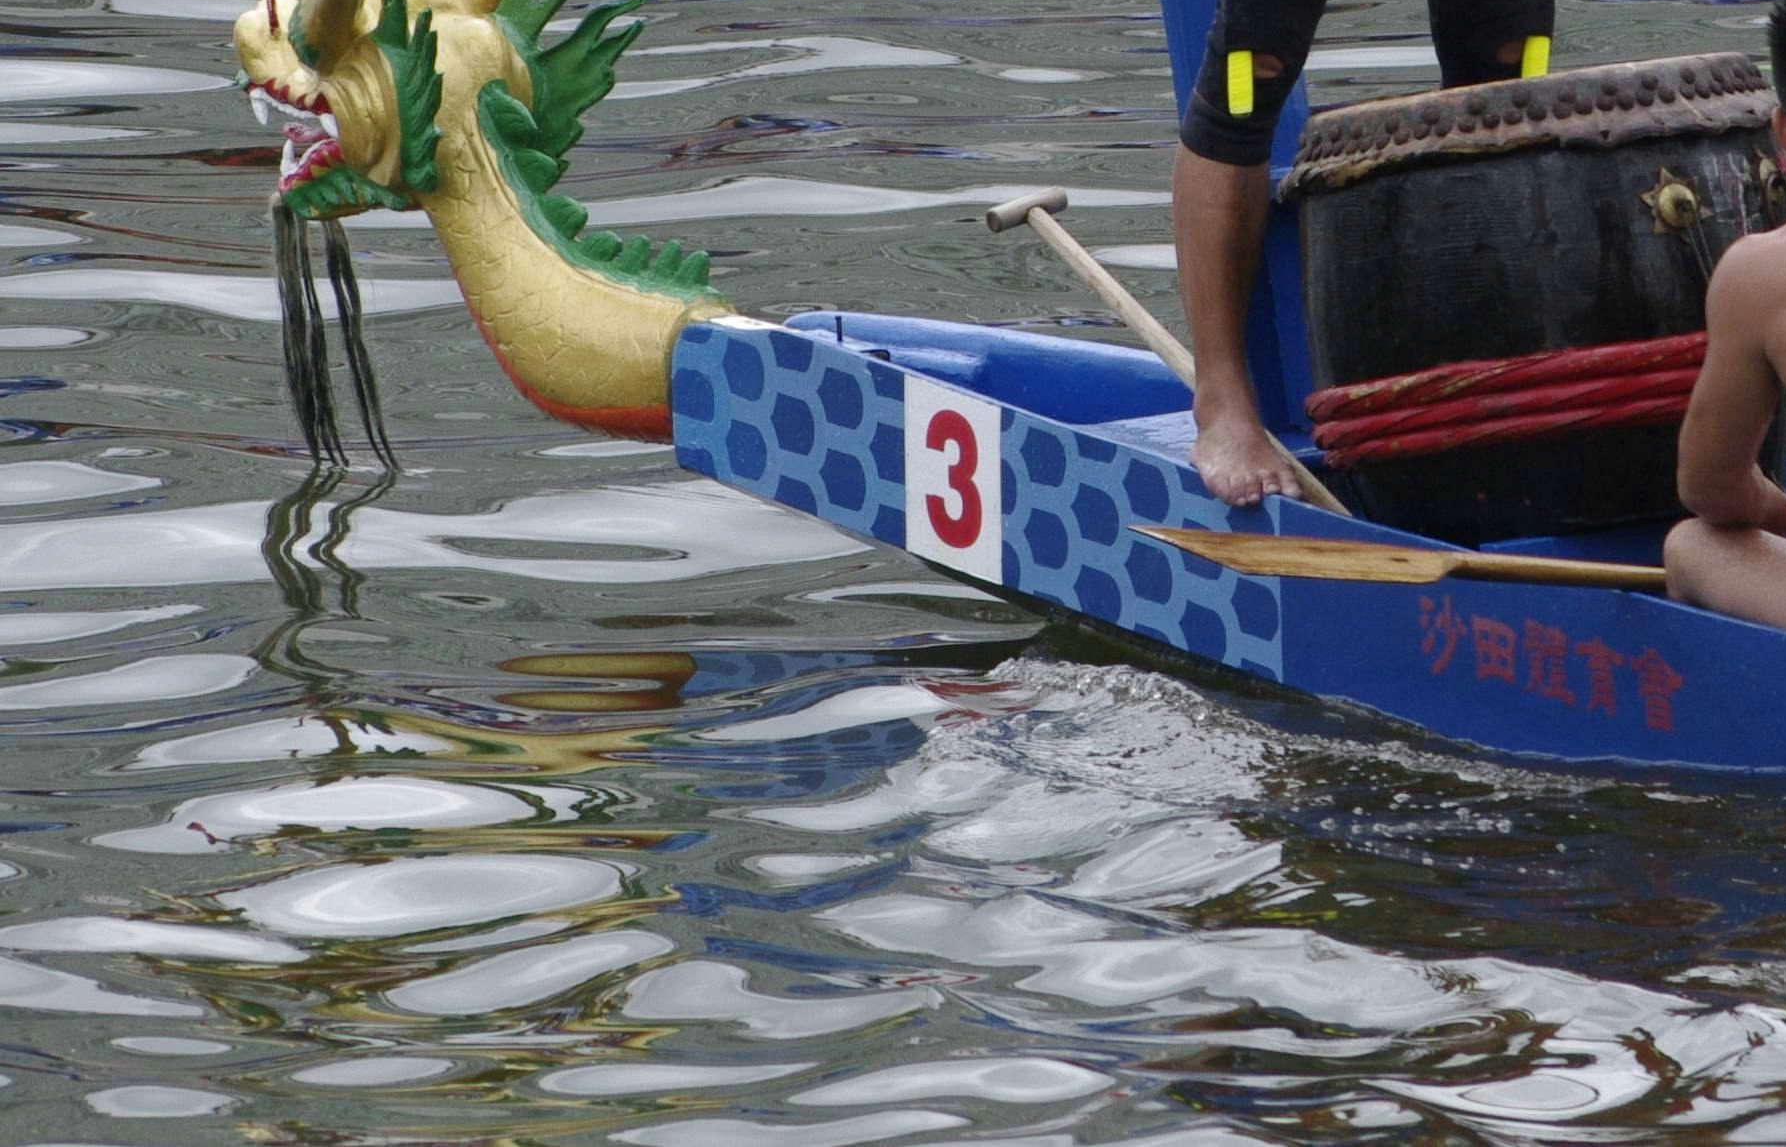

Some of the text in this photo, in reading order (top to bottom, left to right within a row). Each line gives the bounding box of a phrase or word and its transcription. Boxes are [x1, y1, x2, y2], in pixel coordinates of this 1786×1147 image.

[925, 409, 983, 549] 3
[1418, 595, 1686, 732] 沙田體育會
